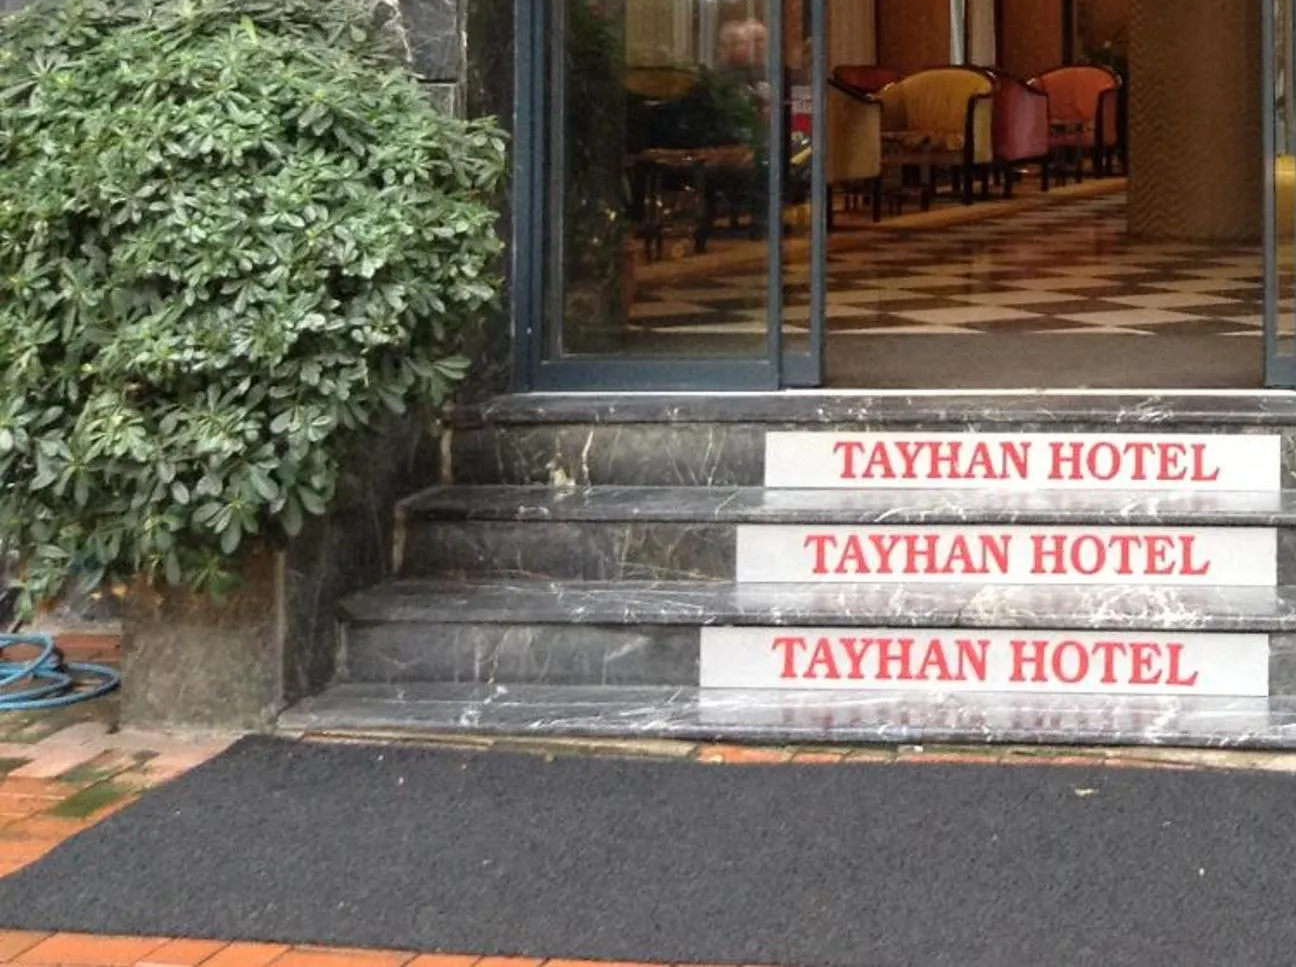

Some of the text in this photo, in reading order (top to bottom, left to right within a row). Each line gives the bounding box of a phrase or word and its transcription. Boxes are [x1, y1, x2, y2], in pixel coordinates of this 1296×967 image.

[833, 441, 1220, 481] TAYHAN HOTEL
[803, 534, 1211, 575] TAYHAN HOTEL
[772, 637, 1200, 687] TAYHAN HOTEL
